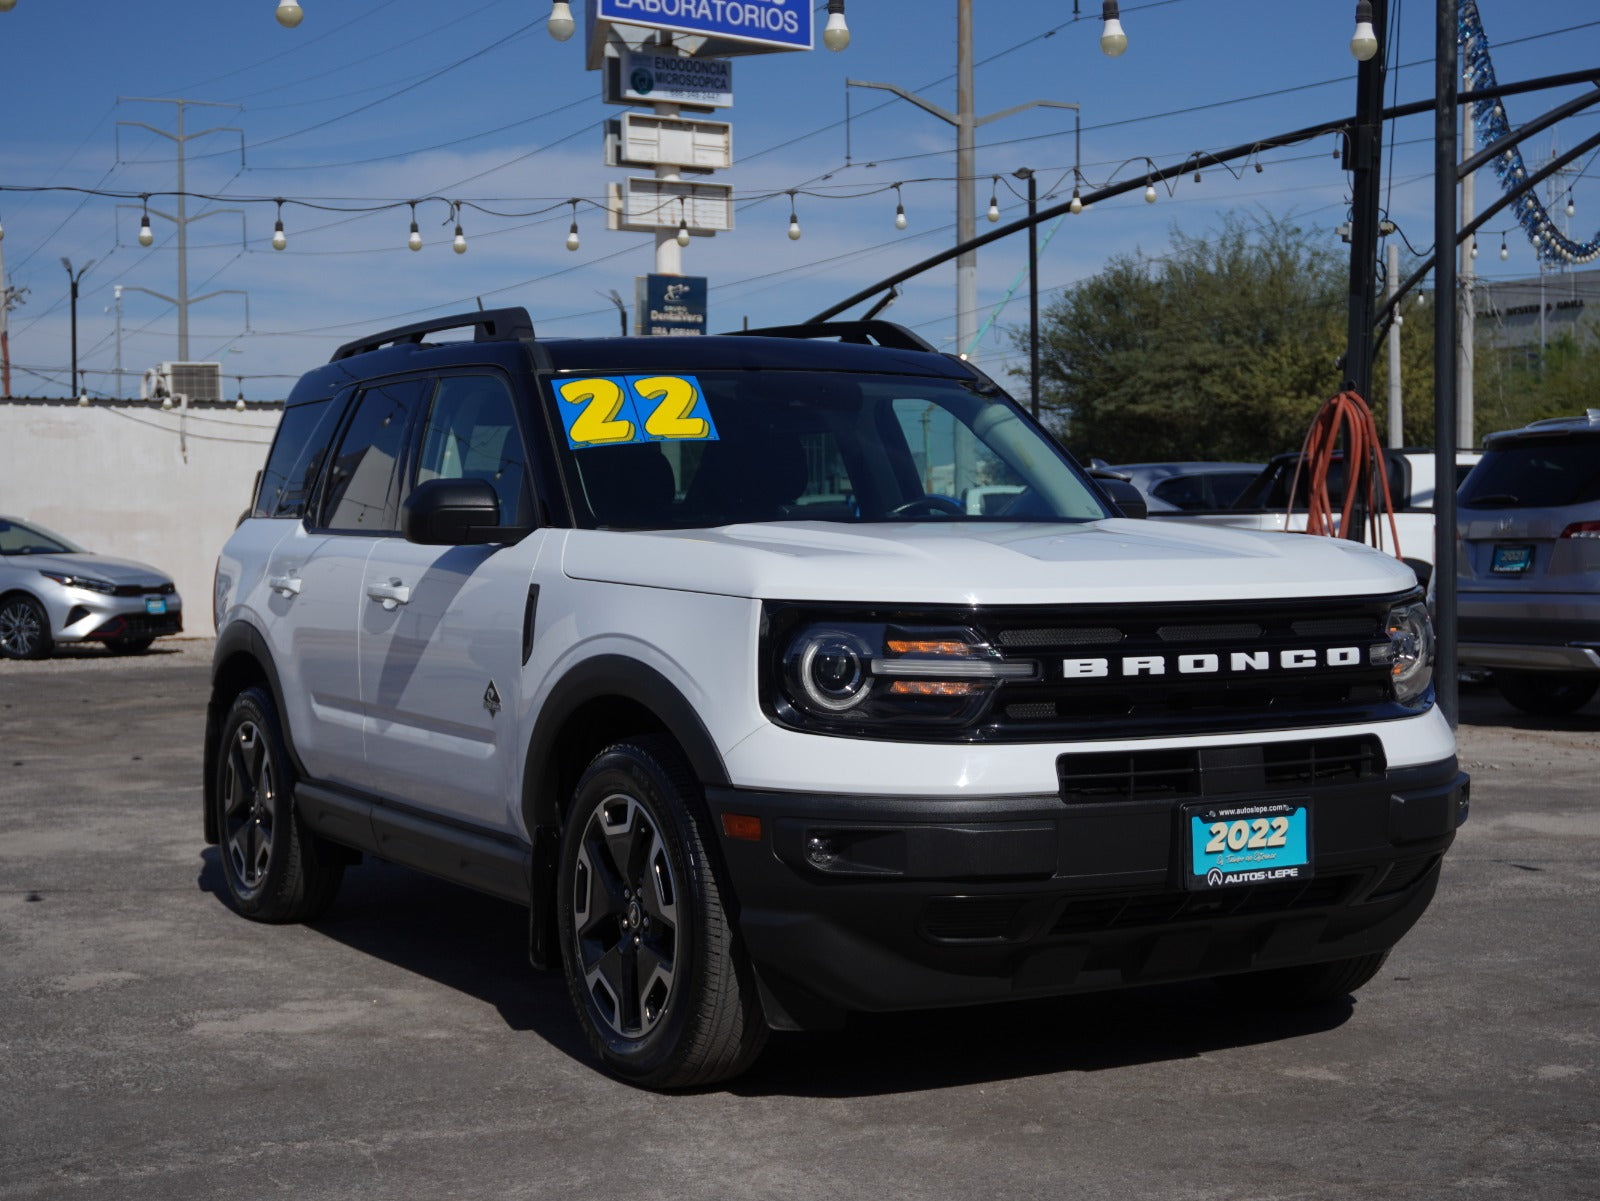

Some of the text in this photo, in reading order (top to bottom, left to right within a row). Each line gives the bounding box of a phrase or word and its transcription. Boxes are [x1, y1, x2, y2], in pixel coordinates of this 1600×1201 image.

[654, 57, 728, 76] ENDODONCIA
[1063, 647, 1360, 678] BRONCO
[1218, 804, 1284, 816] www.autoslepe.com
[1205, 816, 1289, 853] 2022
